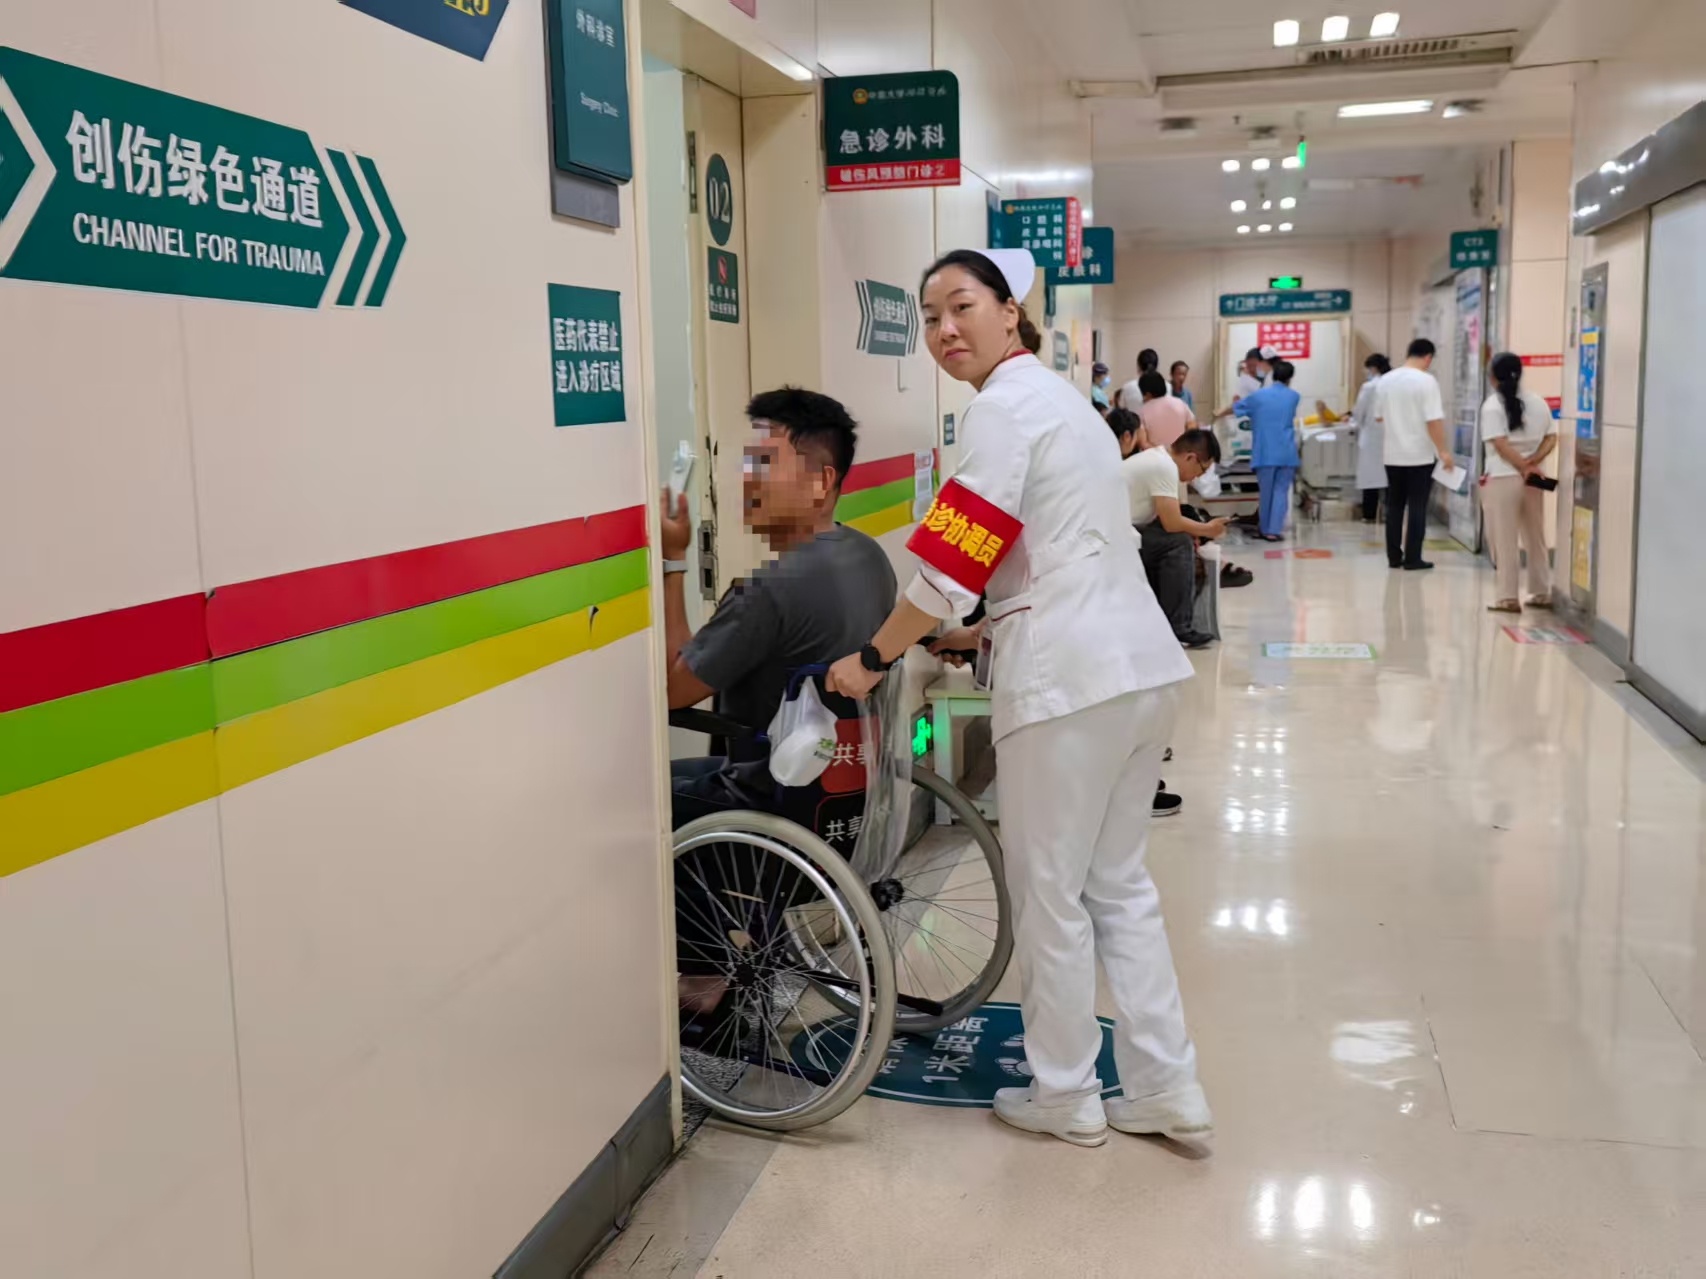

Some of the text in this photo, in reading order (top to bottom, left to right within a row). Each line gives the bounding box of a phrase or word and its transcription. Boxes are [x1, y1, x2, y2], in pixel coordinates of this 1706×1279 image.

[839, 123, 946, 155] 急诊外科
[65, 109, 323, 229] 创伤绿色通道
[709, 176, 731, 224] 02
[72, 212, 326, 277] CHANNEL FOR TRAUMA
[553, 317, 620, 352] 医药代表禁止
[555, 359, 622, 393] 进入诊疗区域
[922, 498, 1005, 568] 诊协调员
